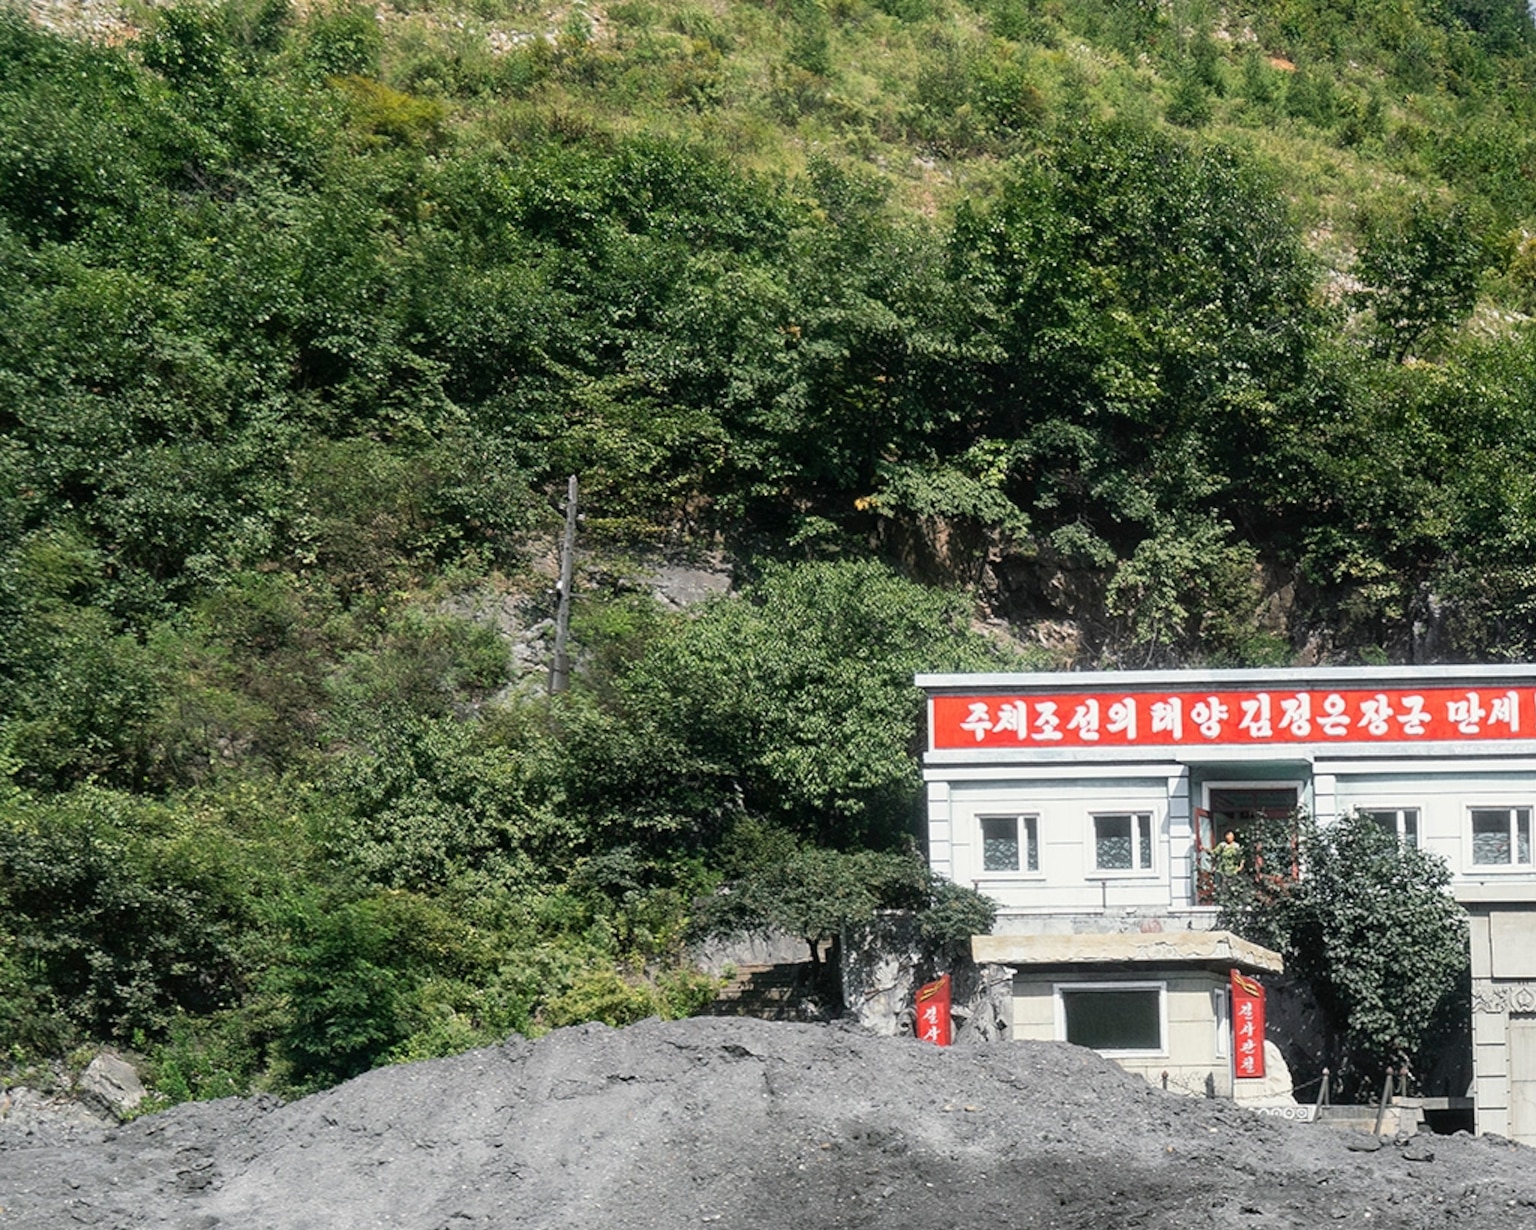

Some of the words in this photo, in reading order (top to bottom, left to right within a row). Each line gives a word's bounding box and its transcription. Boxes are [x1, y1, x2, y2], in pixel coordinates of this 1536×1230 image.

[960, 697, 1136, 741] 주체조선의
[1150, 697, 1229, 738] 태양
[1238, 691, 1432, 738] 김정은장군
